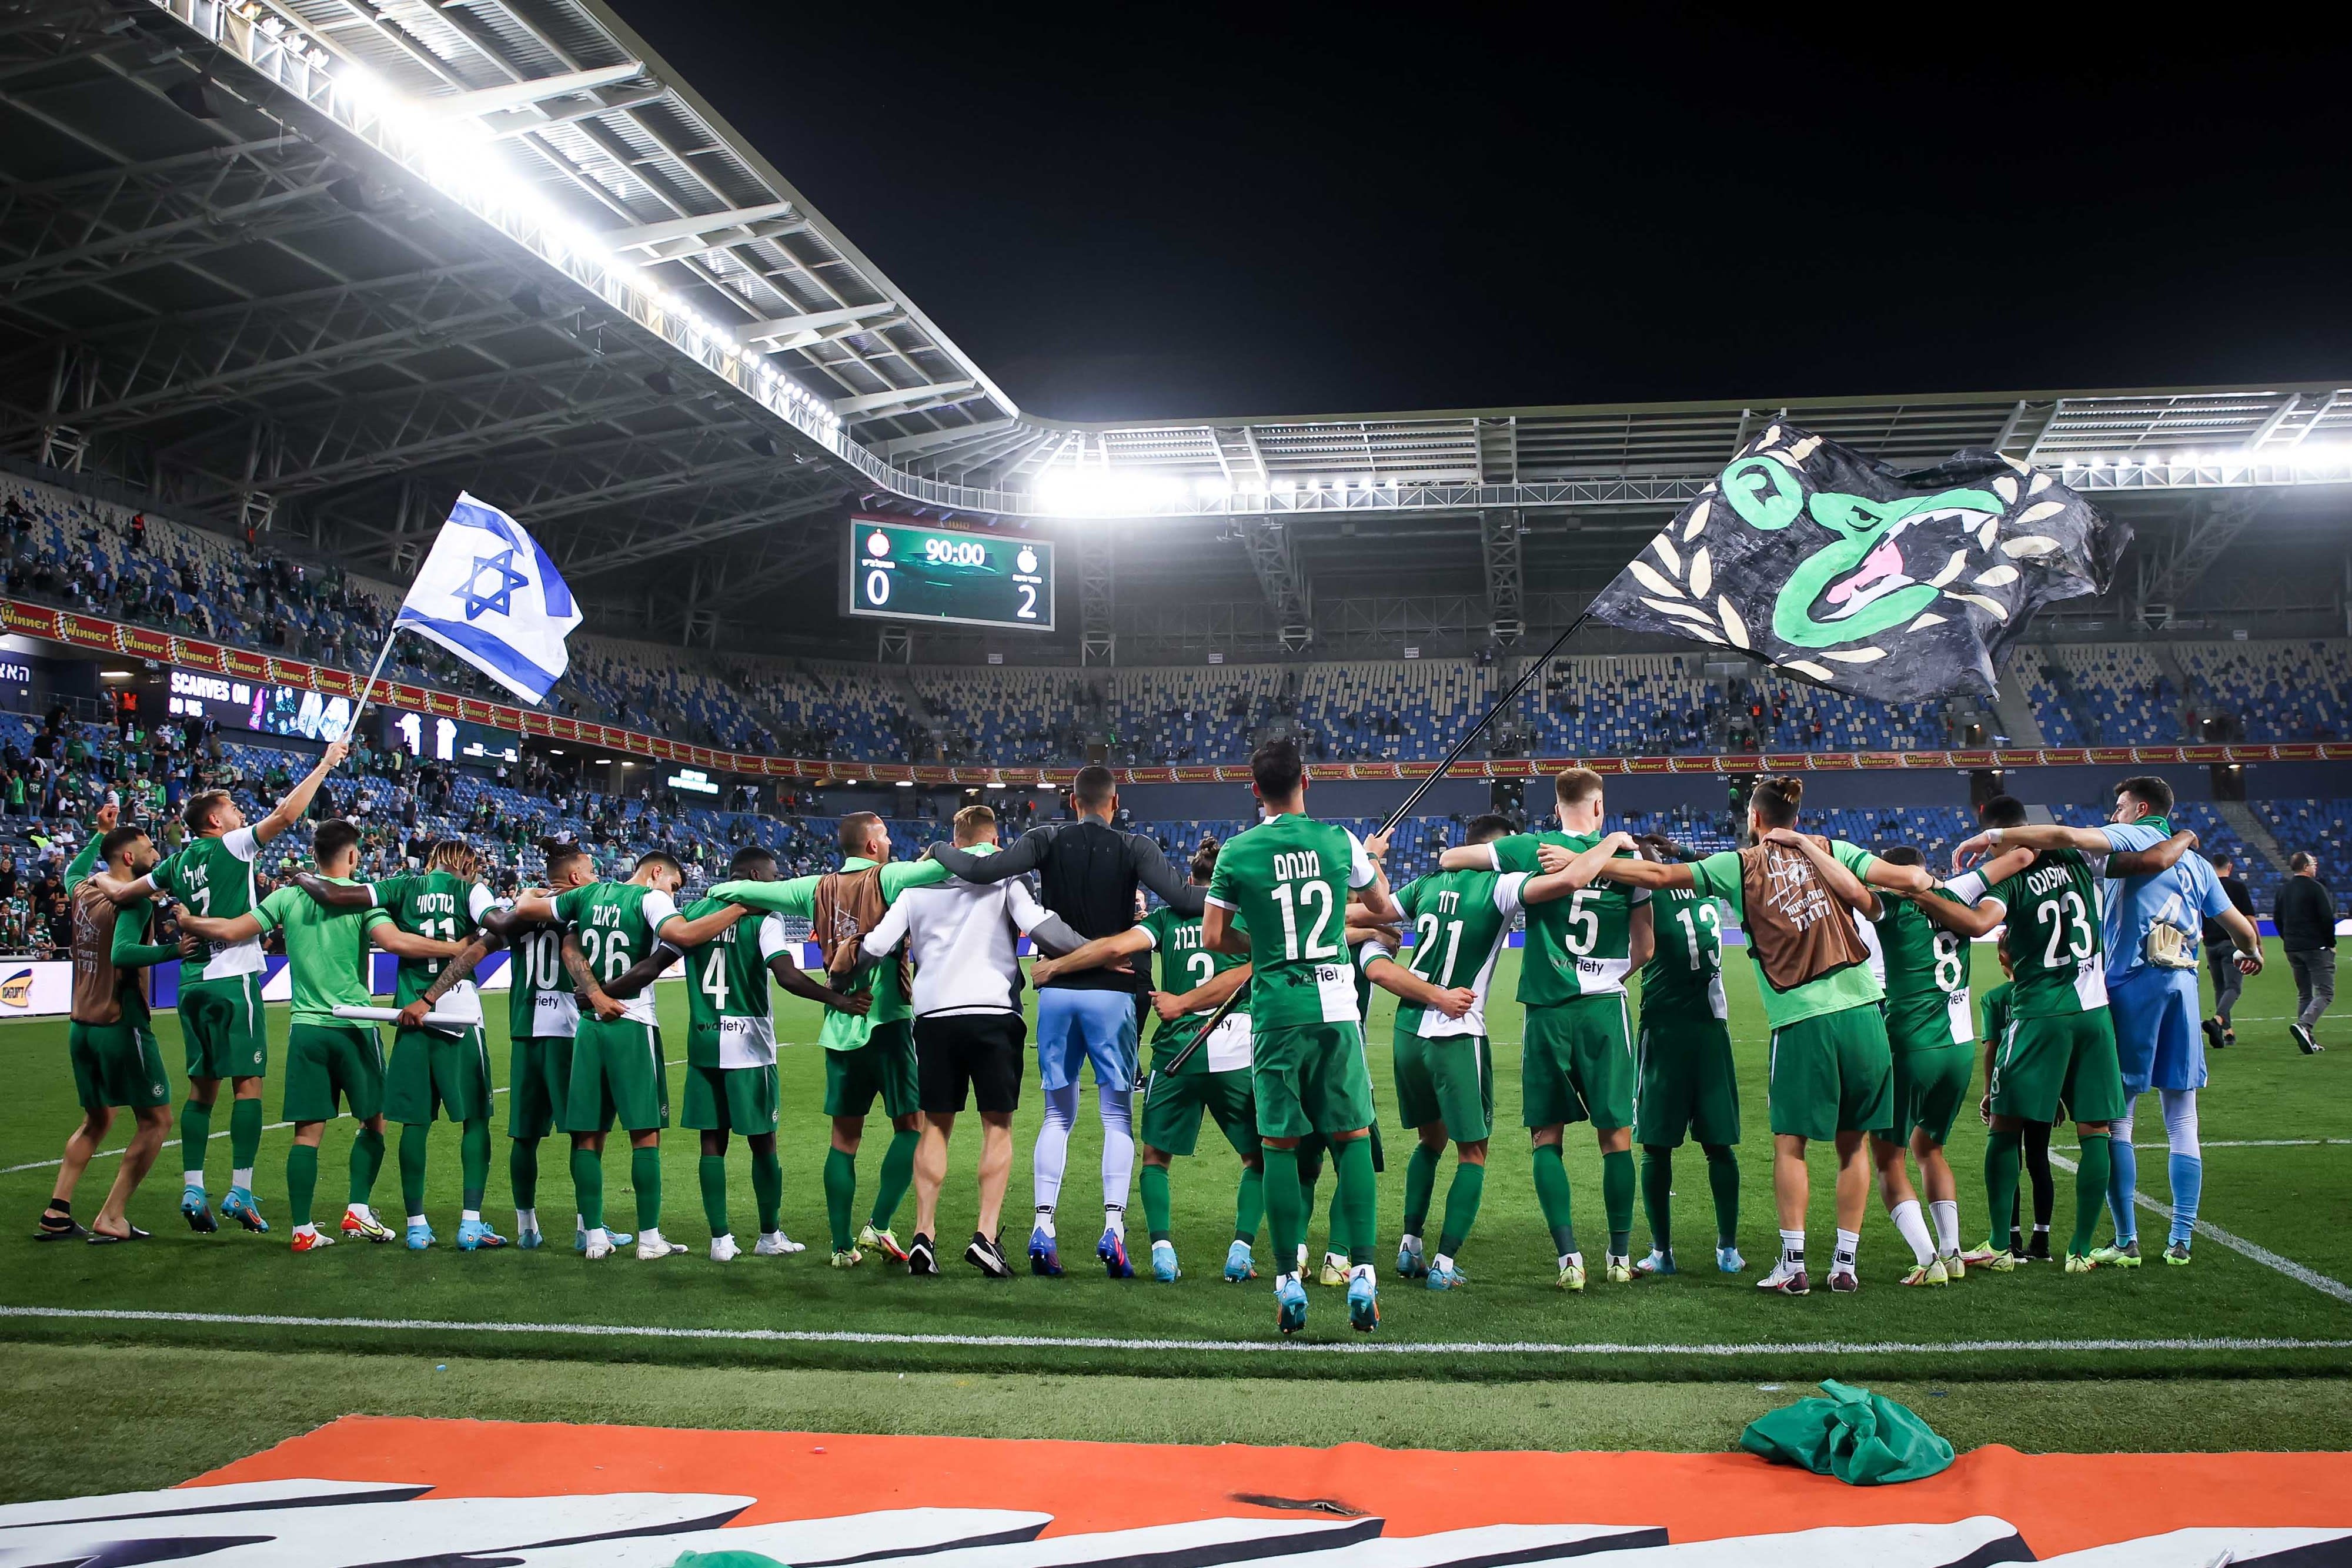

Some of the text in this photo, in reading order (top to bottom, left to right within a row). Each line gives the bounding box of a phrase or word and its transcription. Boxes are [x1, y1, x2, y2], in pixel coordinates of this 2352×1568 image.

[925, 539, 985, 566] 90:00
[867, 570, 890, 605] 0
[1017, 584, 1037, 618] 2
[171, 671, 250, 705] SCARVES ON
[356, 682, 384, 697] Wner
[1045, 771, 1074, 781] Winne
[1274, 850, 1321, 881] מנחם
[191, 887, 210, 918] 7
[417, 893, 455, 914] גודסווי
[1271, 880, 1338, 960] 12
[1565, 889, 1601, 955] 5
[1676, 903, 1722, 971] 13
[2037, 891, 2093, 968] 23
[1174, 925, 1204, 950] דברג
[1408, 912, 1464, 987] 21
[520, 930, 559, 989] 10
[582, 928, 631, 983] 26
[1933, 931, 1962, 992] 8
[703, 948, 729, 1009] 4
[535, 995, 559, 1009] riety
[706, 1021, 746, 1034] variety
